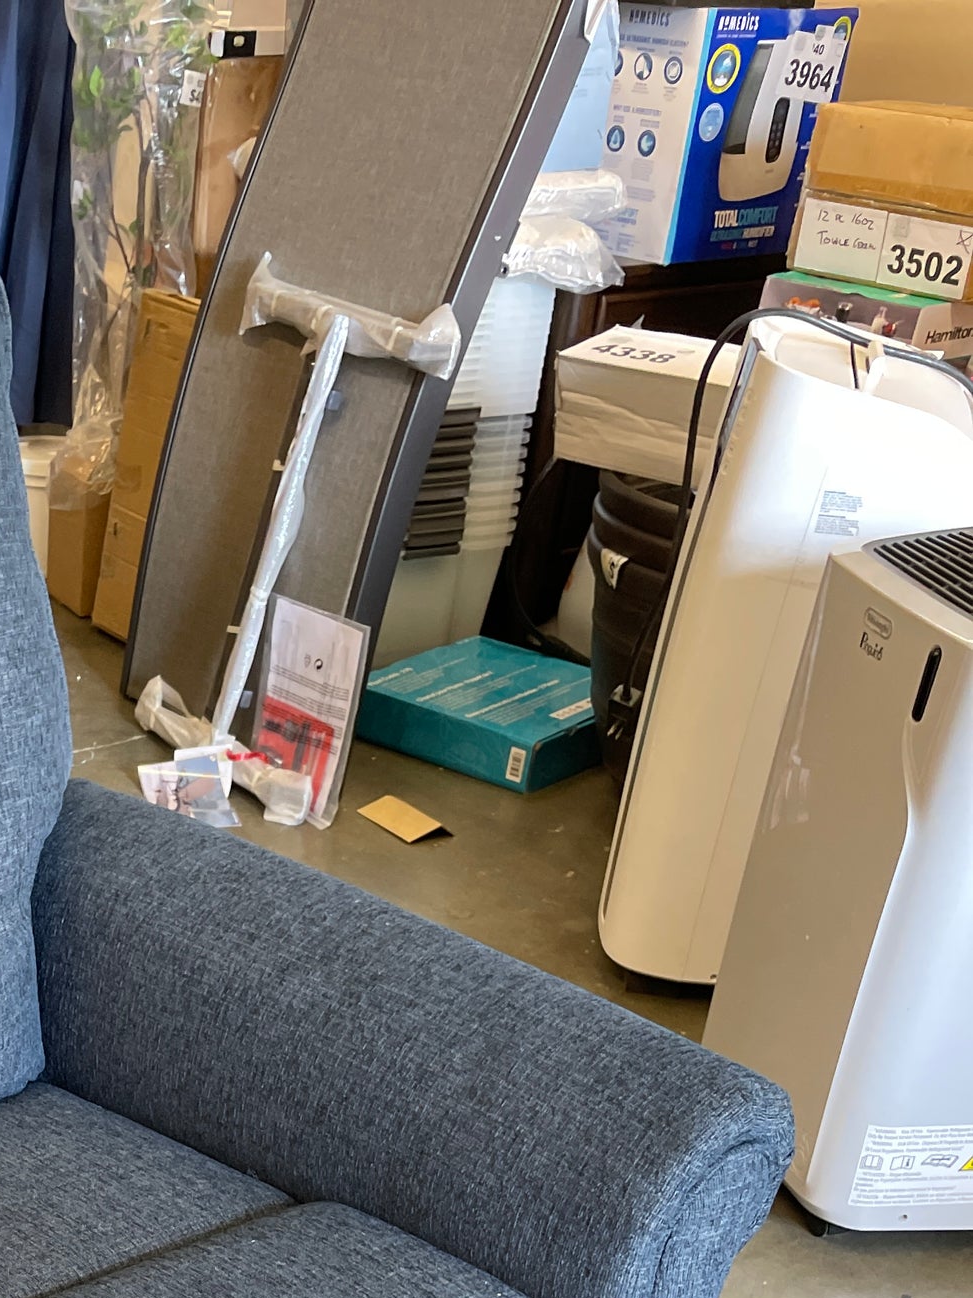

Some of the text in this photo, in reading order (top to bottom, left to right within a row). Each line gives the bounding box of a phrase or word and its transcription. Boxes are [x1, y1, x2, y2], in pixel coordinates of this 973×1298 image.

[784, 59, 835, 93] 3964
[714, 209, 738, 229] TOTAL
[817, 210, 830, 222] 12
[887, 244, 964, 287] 3502
[592, 344, 676, 364] 4338
